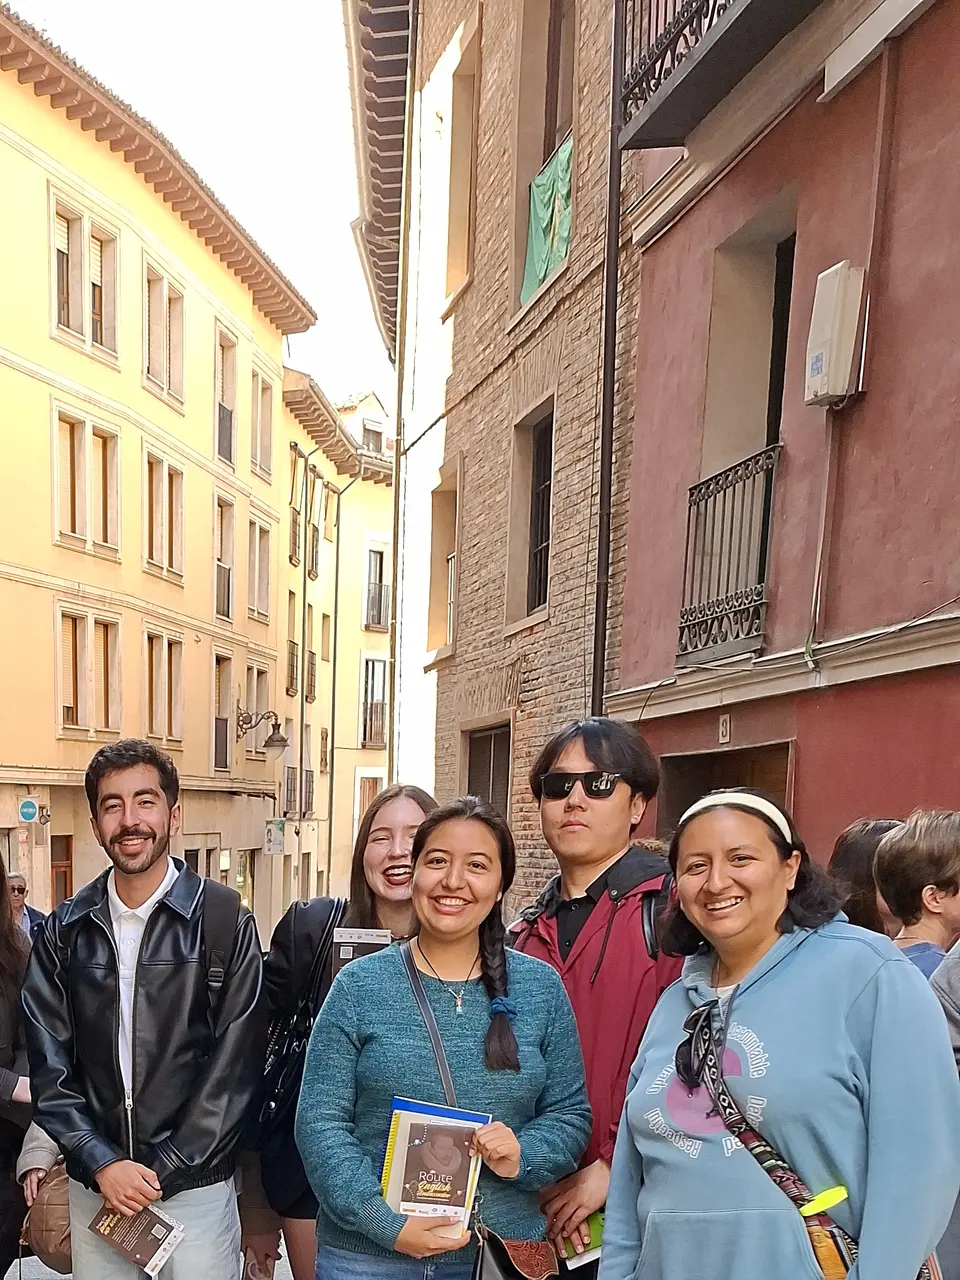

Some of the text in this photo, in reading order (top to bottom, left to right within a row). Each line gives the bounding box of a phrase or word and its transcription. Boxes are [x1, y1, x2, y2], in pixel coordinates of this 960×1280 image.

[721, 718, 728, 738] 3
[643, 1107, 703, 1158] Respectful
[419, 1170, 453, 1183] Route
[418, 1180, 452, 1193] English
